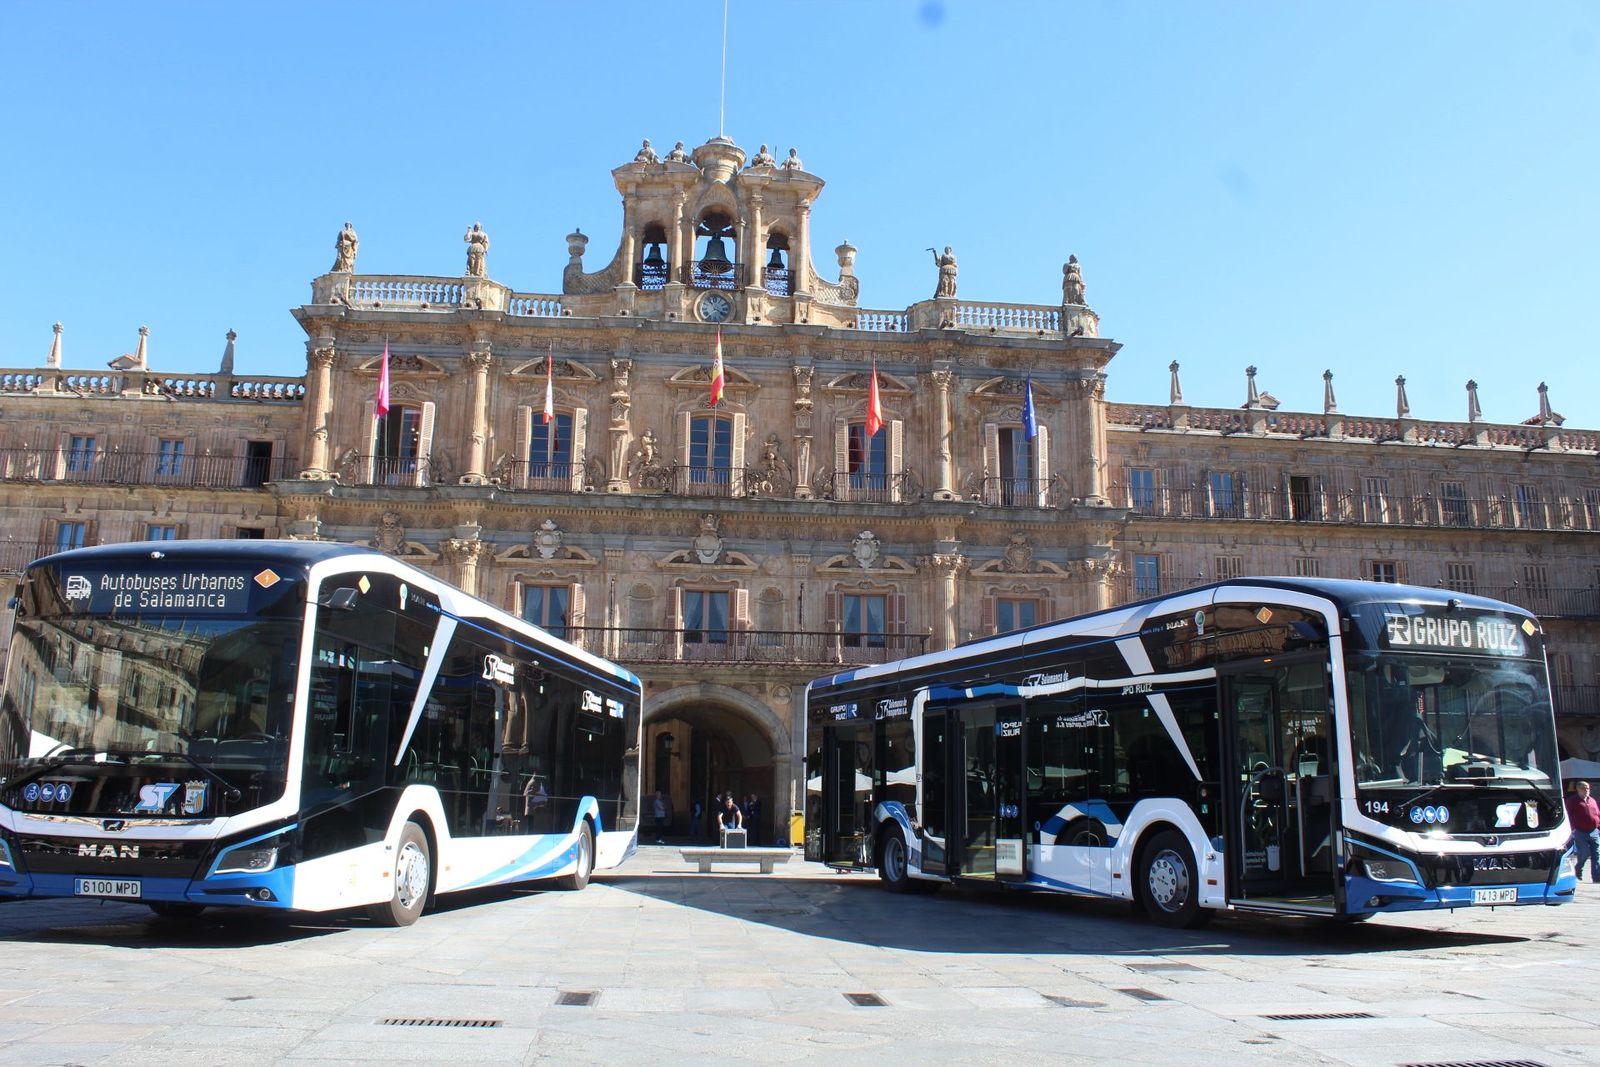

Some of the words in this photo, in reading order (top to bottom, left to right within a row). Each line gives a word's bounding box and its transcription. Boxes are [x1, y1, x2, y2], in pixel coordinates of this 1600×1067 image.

[100, 574, 177, 589] Autobuses
[182, 574, 244, 589] Urbanos
[114, 591, 132, 608] de
[139, 591, 226, 608] Salamanca
[1414, 617, 1472, 648] GRUPO
[1477, 622, 1519, 651] RUIZ
[830, 705, 846, 714] GRUPO
[1365, 801, 1389, 814] 194
[78, 844, 140, 859] MAN
[1472, 857, 1516, 871] MAN
[83, 881, 112, 893] 6100
[116, 882, 138, 895] MPD
[1478, 890, 1497, 901] 1413
[1499, 889, 1515, 900] MPD
